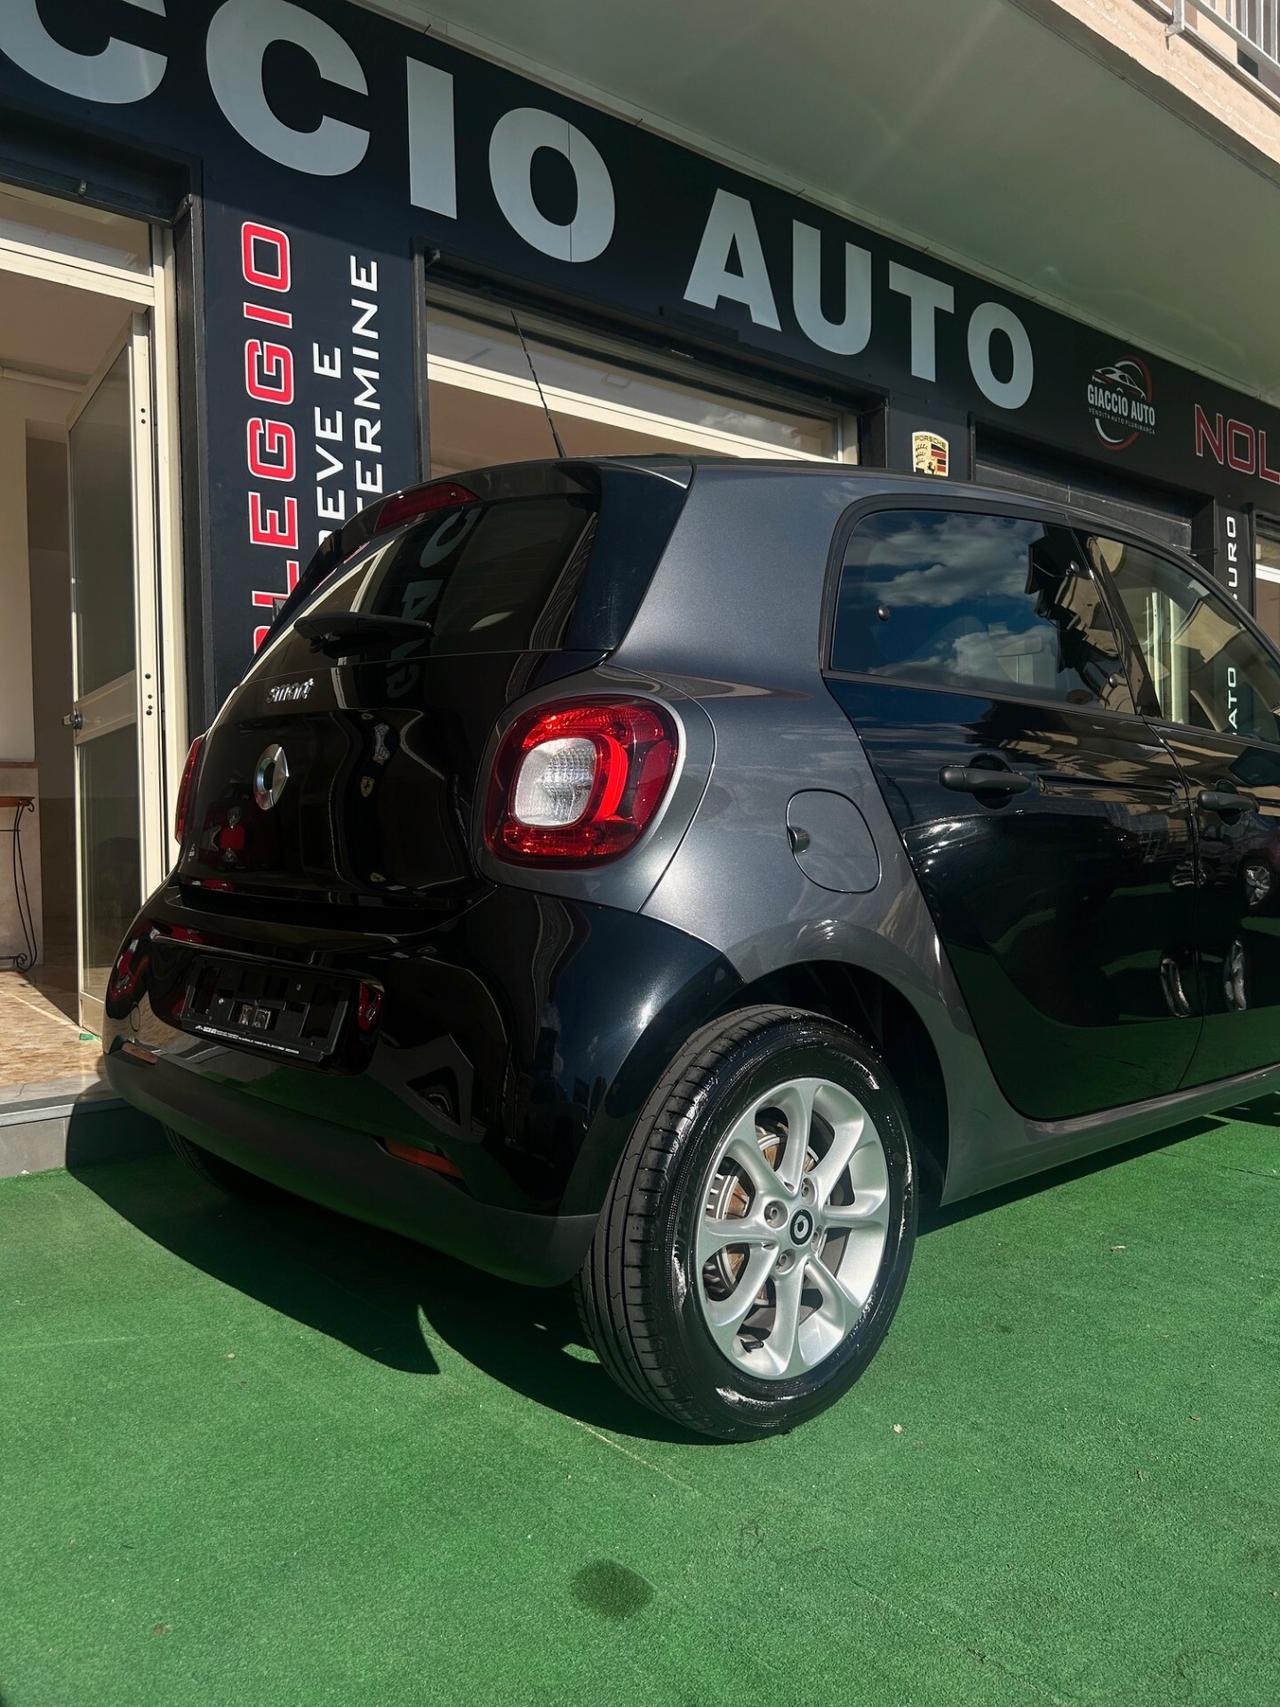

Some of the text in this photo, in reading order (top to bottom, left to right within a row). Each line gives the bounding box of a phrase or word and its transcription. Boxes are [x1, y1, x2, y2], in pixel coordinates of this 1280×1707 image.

[312, 342, 342, 379] E
[350, 255, 384, 513] ERMINE
[683, 188, 1034, 410] AUTO
[1087, 383, 1156, 426] GIACCIO AUTO
[241, 221, 300, 655] LEGGIO
[1226, 516, 1238, 736] ATO URO
